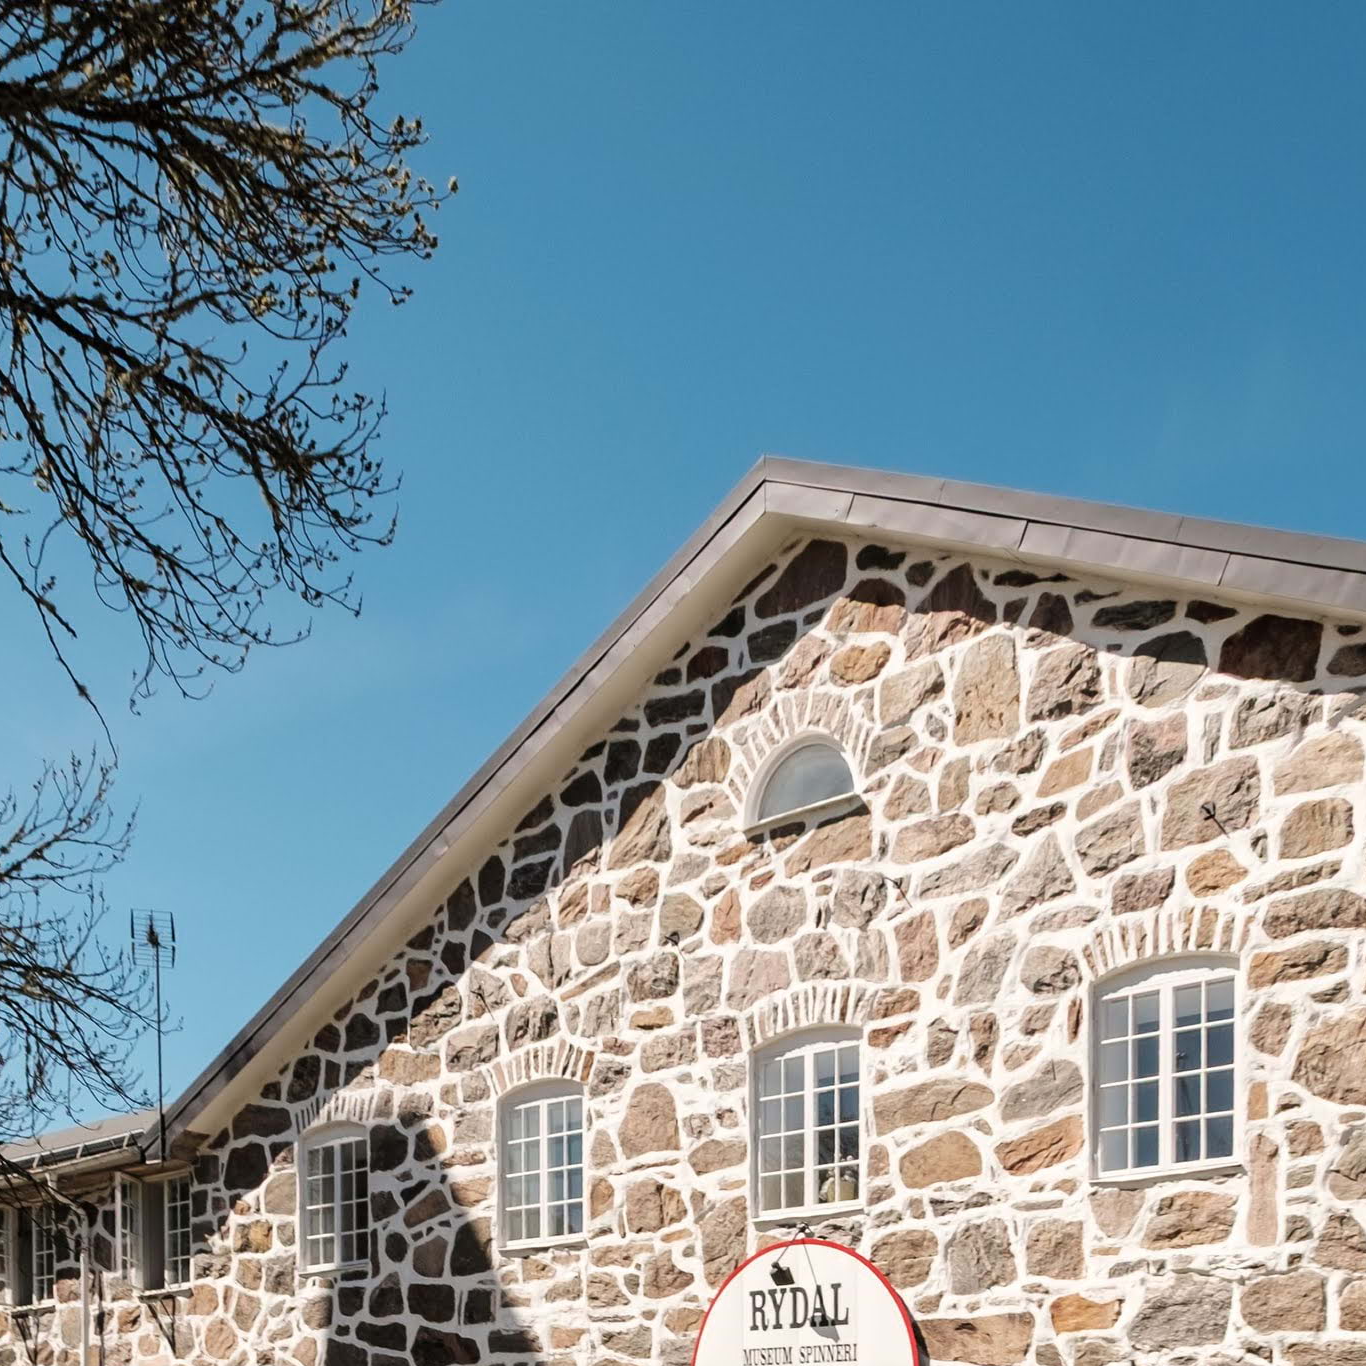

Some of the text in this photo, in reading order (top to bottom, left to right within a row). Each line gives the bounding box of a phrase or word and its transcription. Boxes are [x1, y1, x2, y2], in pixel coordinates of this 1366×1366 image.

[749, 1283, 849, 1331] RYDAL
[743, 1343, 857, 1366] MUSEUM SPINNERI
